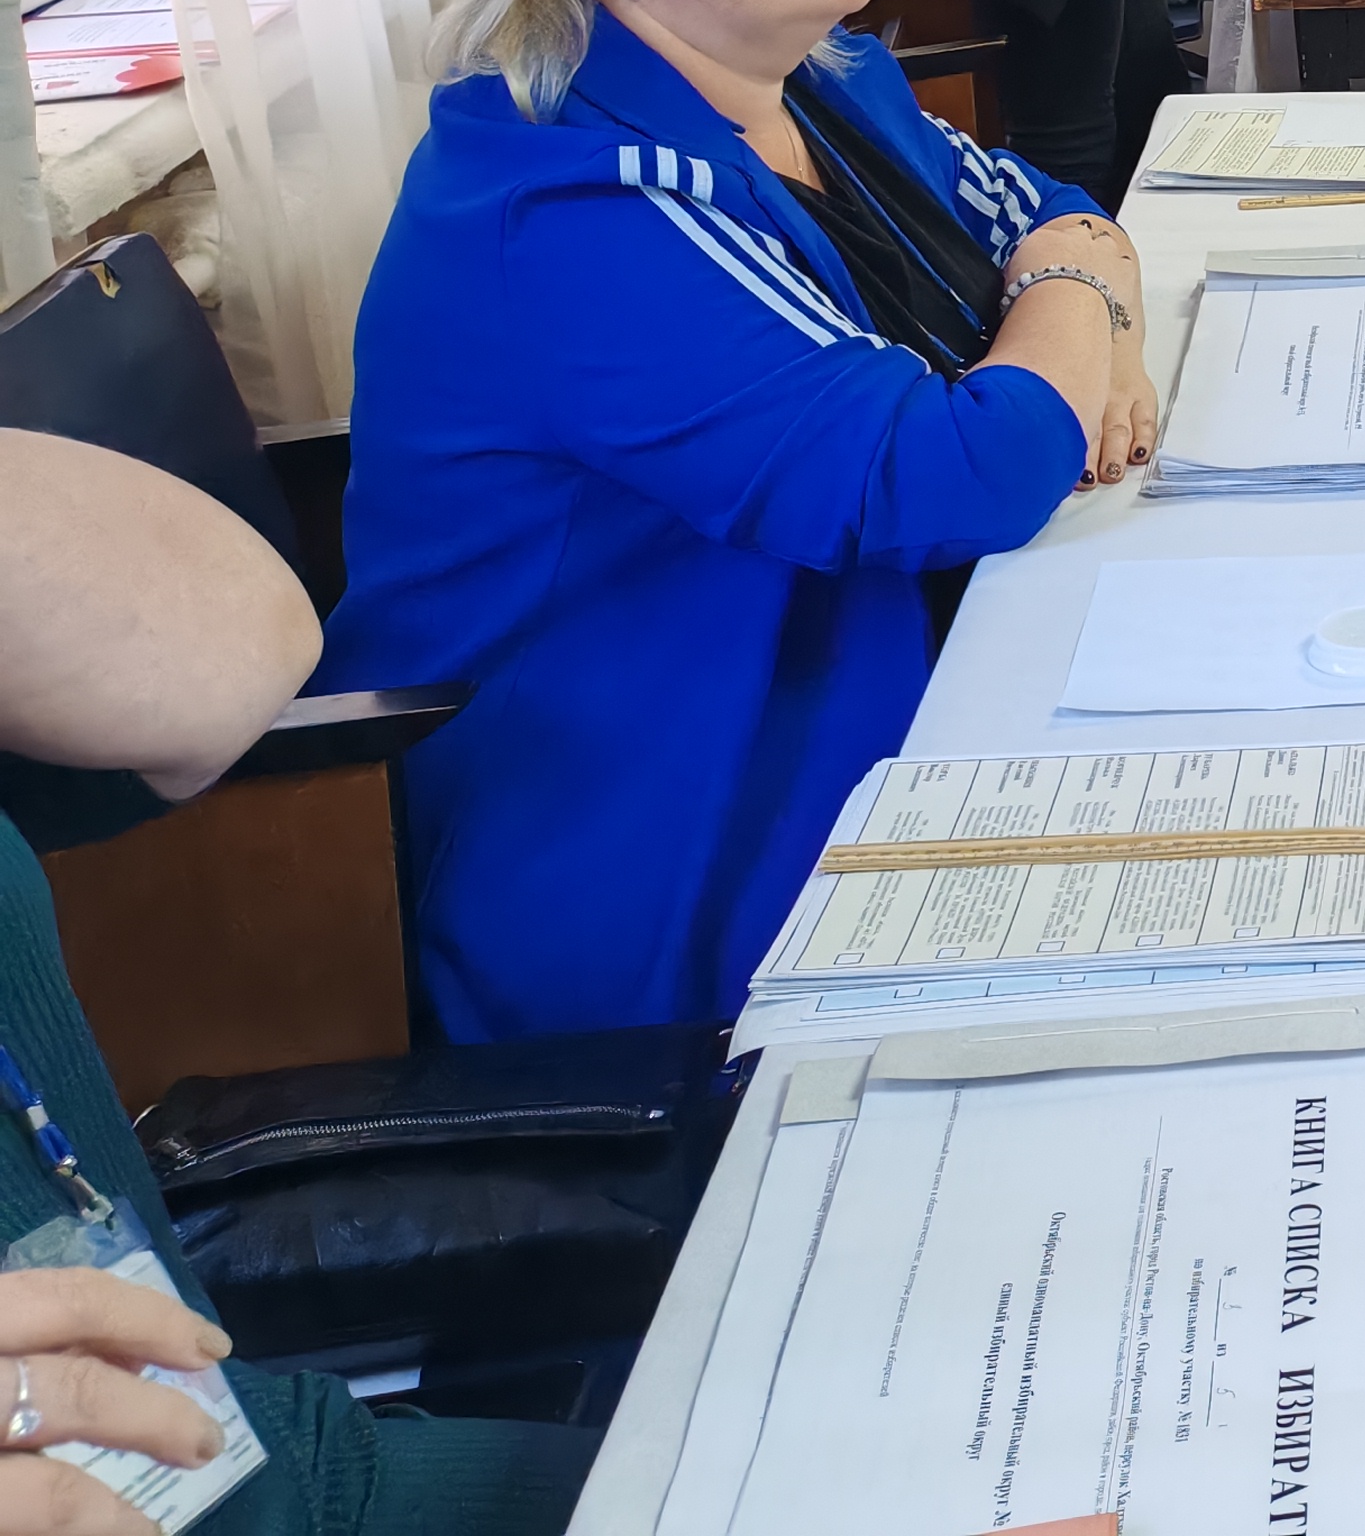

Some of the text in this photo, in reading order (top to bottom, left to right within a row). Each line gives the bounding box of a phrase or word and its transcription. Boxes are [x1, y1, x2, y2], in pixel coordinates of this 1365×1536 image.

[1290, 1096, 1328, 1196] КНИГА
[1155, 1167, 1174, 1212] Ростовская
[1151, 1213, 1167, 1245] область,
[1223, 1265, 1238, 1277] №
[1281, 1203, 1323, 1333] СПИСКА
[1137, 1268, 1160, 1340] Ростов-на-Дону,
[1181, 1270, 1205, 1354] избирательному
[966, 1282, 1014, 1461] единый избирательный округ
[993, 1211, 1067, 1527] Октябрьский одномандатный избирательный округ №
[1216, 1343, 1227, 1357] из
[1130, 1342, 1151, 1415] Октябрьский
[1176, 1359, 1194, 1406] участку
[1123, 1416, 1139, 1444] район,
[1174, 1423, 1191, 1443] 1831
[1178, 1411, 1193, 1423] №
[1117, 1444, 1133, 1488] переулок
